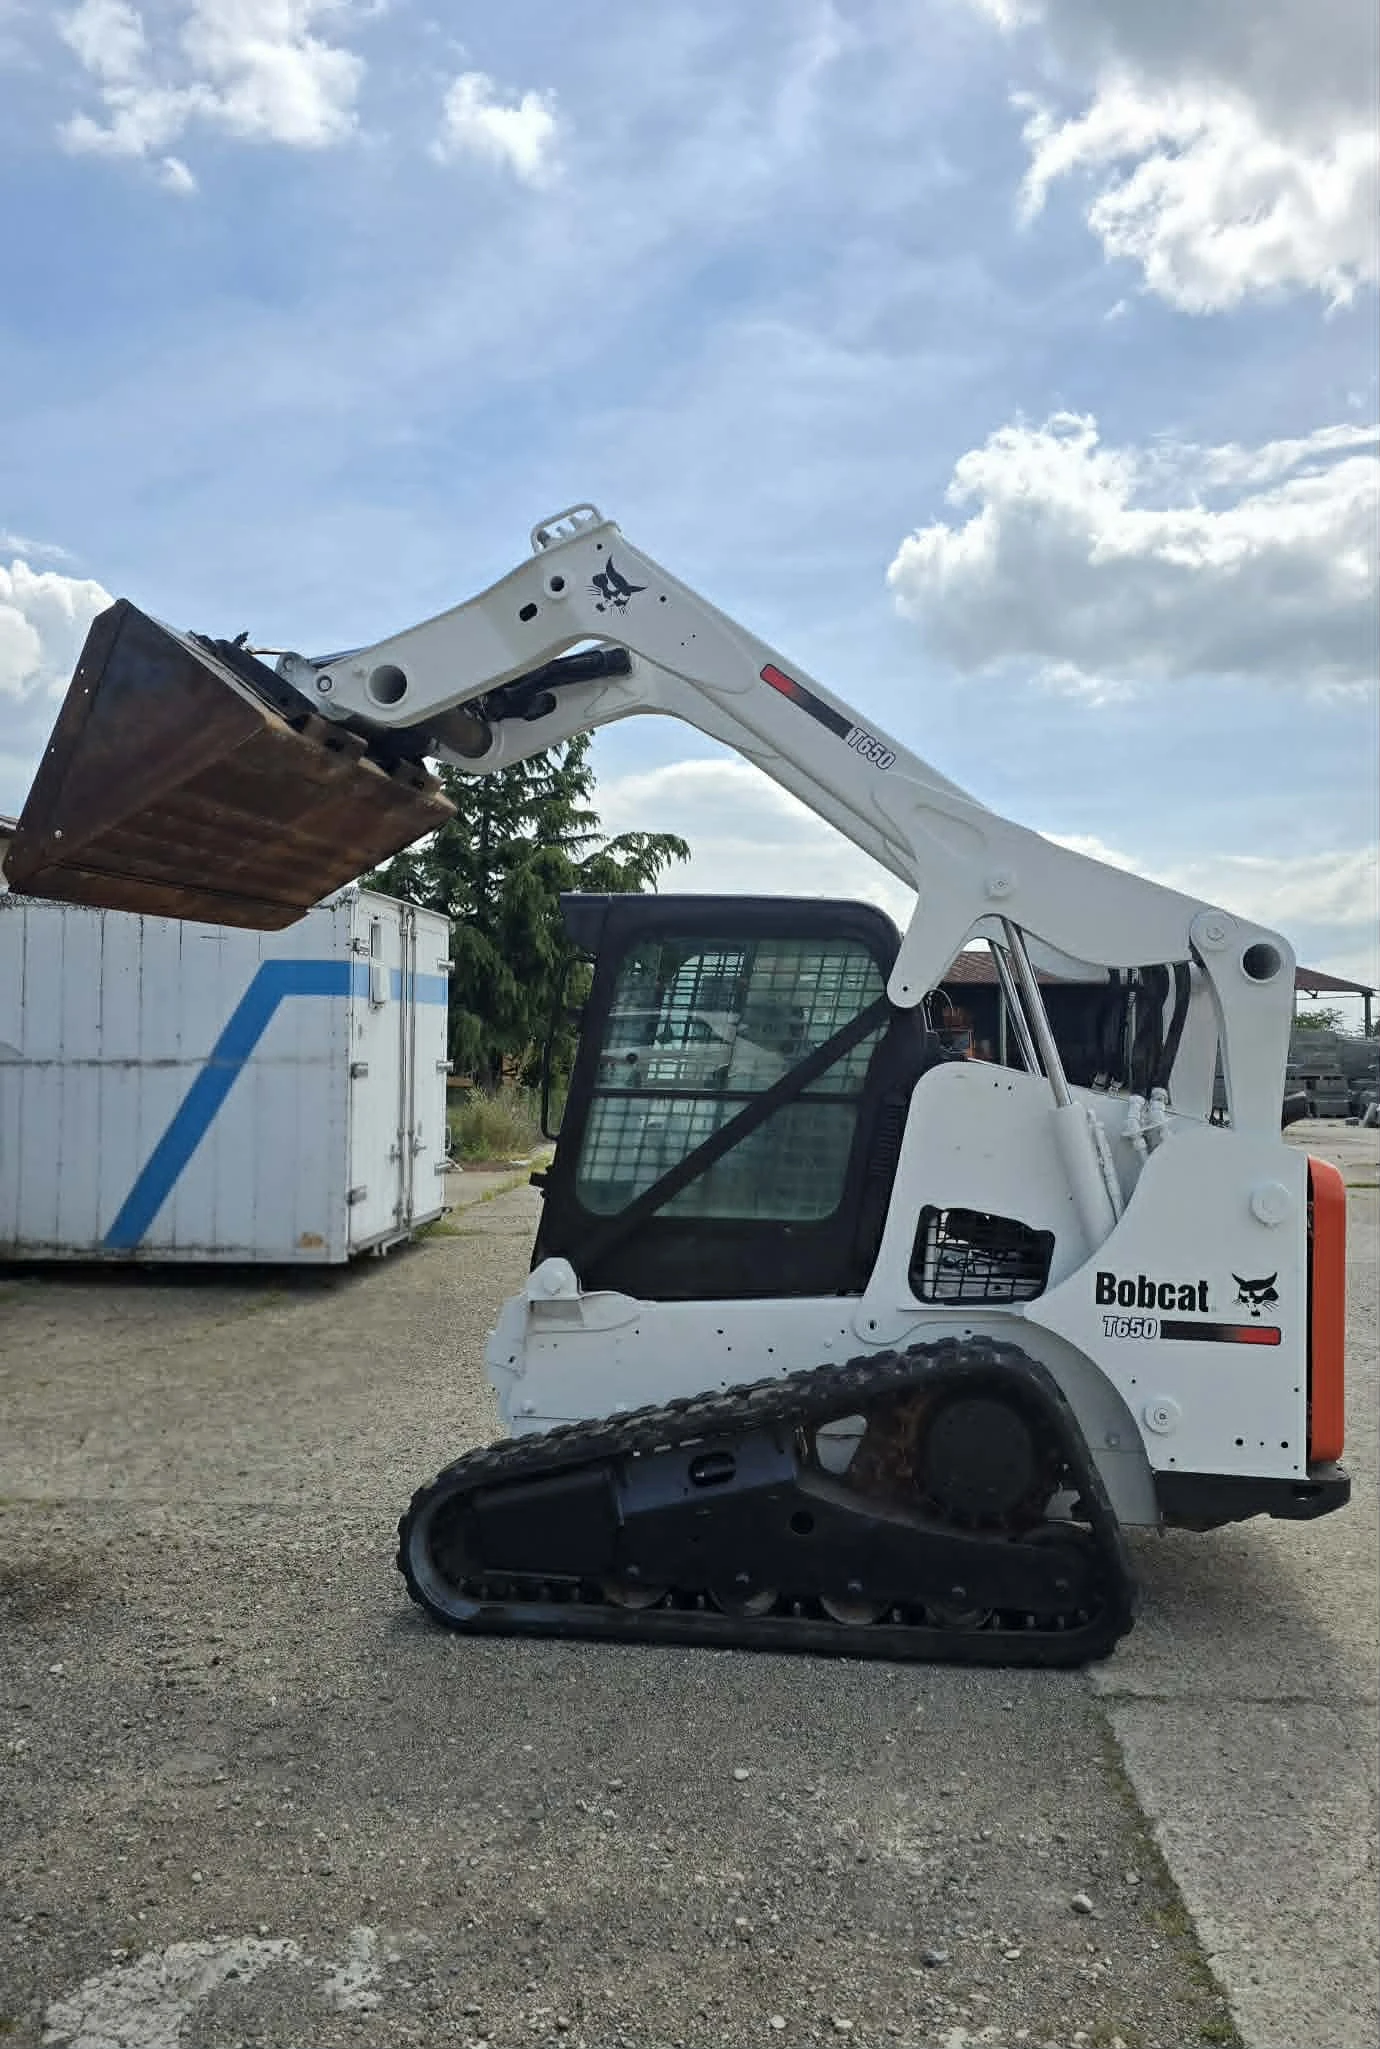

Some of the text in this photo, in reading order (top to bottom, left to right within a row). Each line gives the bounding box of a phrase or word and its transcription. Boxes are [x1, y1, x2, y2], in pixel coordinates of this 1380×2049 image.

[847, 727, 896, 770] T650
[1096, 1271, 1209, 1313] Bobcat
[1103, 1315, 1158, 1339] T650
